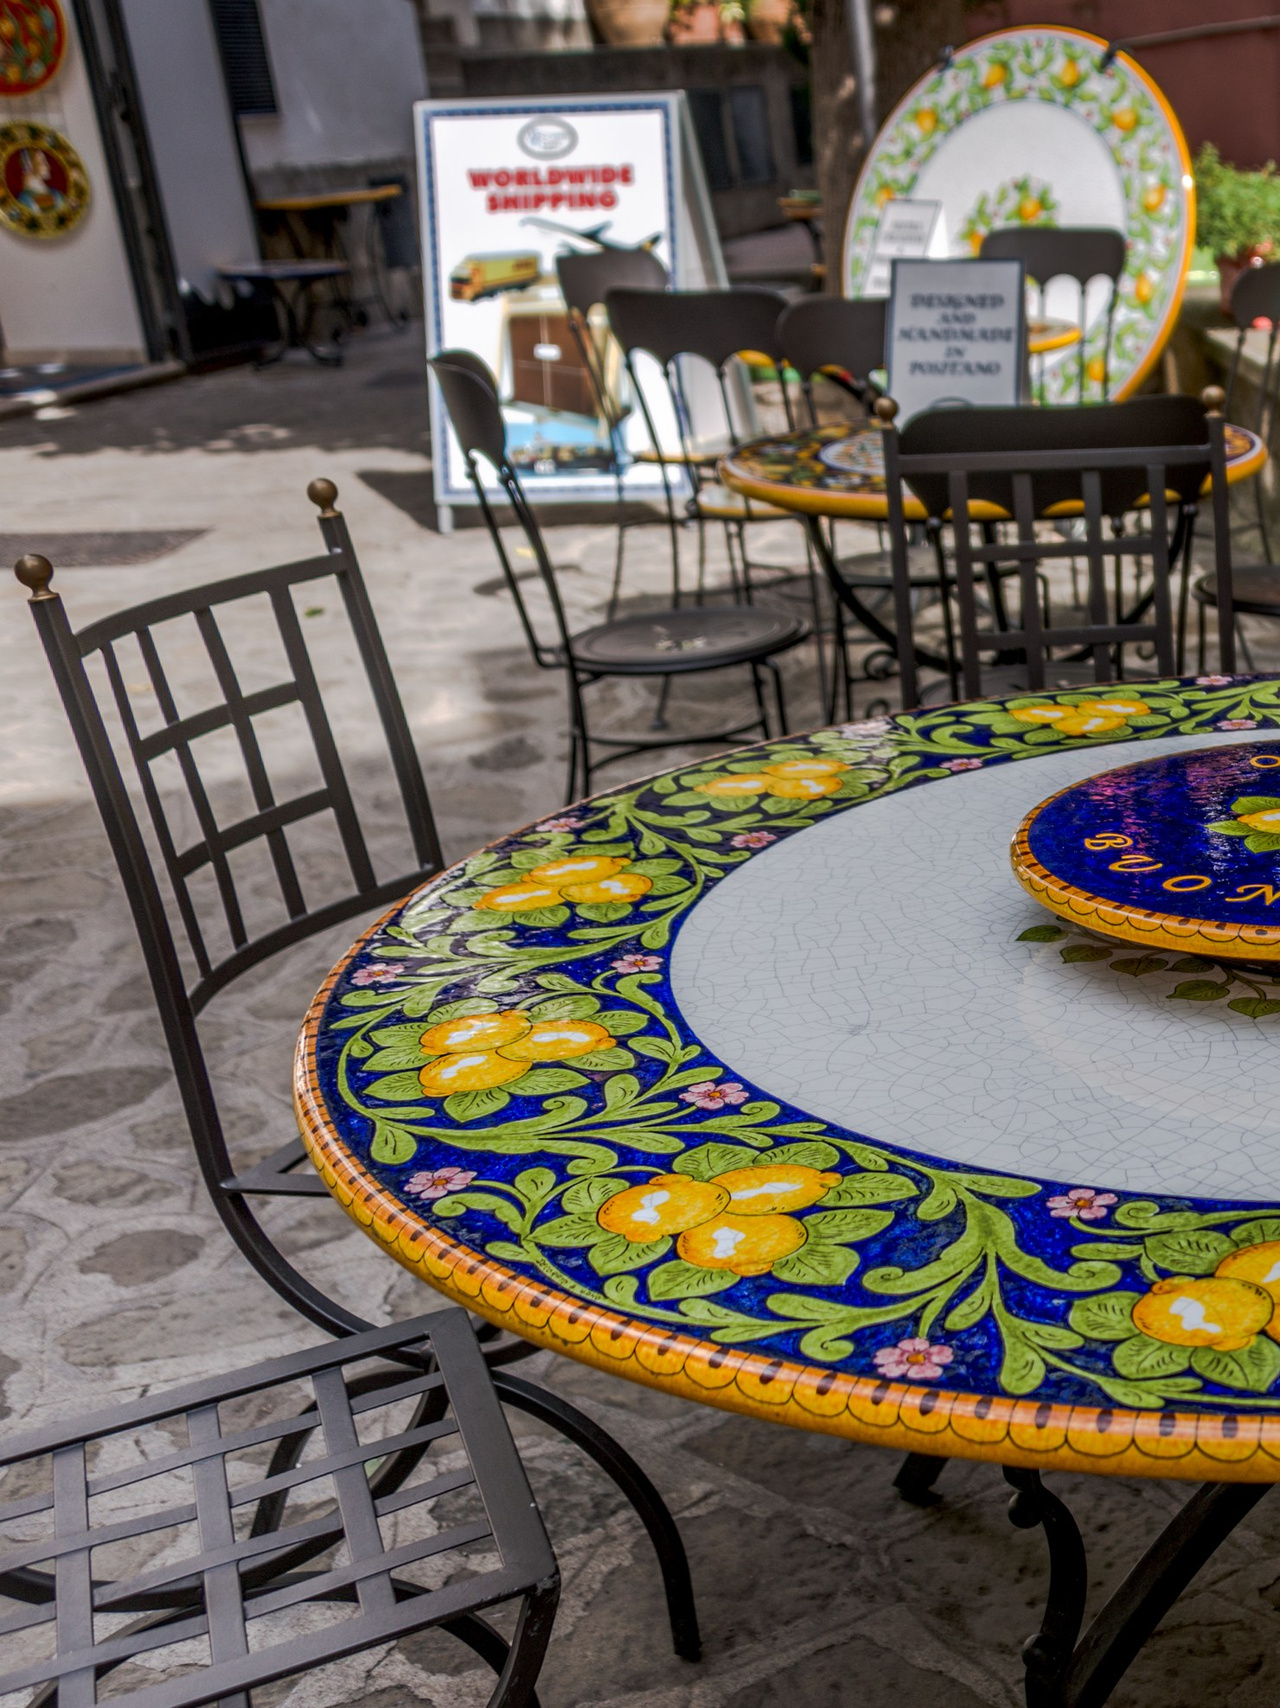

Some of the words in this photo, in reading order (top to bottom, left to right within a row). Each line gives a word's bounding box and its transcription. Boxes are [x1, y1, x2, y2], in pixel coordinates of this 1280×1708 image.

[468, 165, 633, 188] WORLDWIDE
[486, 190, 617, 212] SHIPPING
[911, 294, 1003, 309] DESIGNED
[939, 313, 975, 324] AND
[909, 361, 1001, 375] POSITANO
